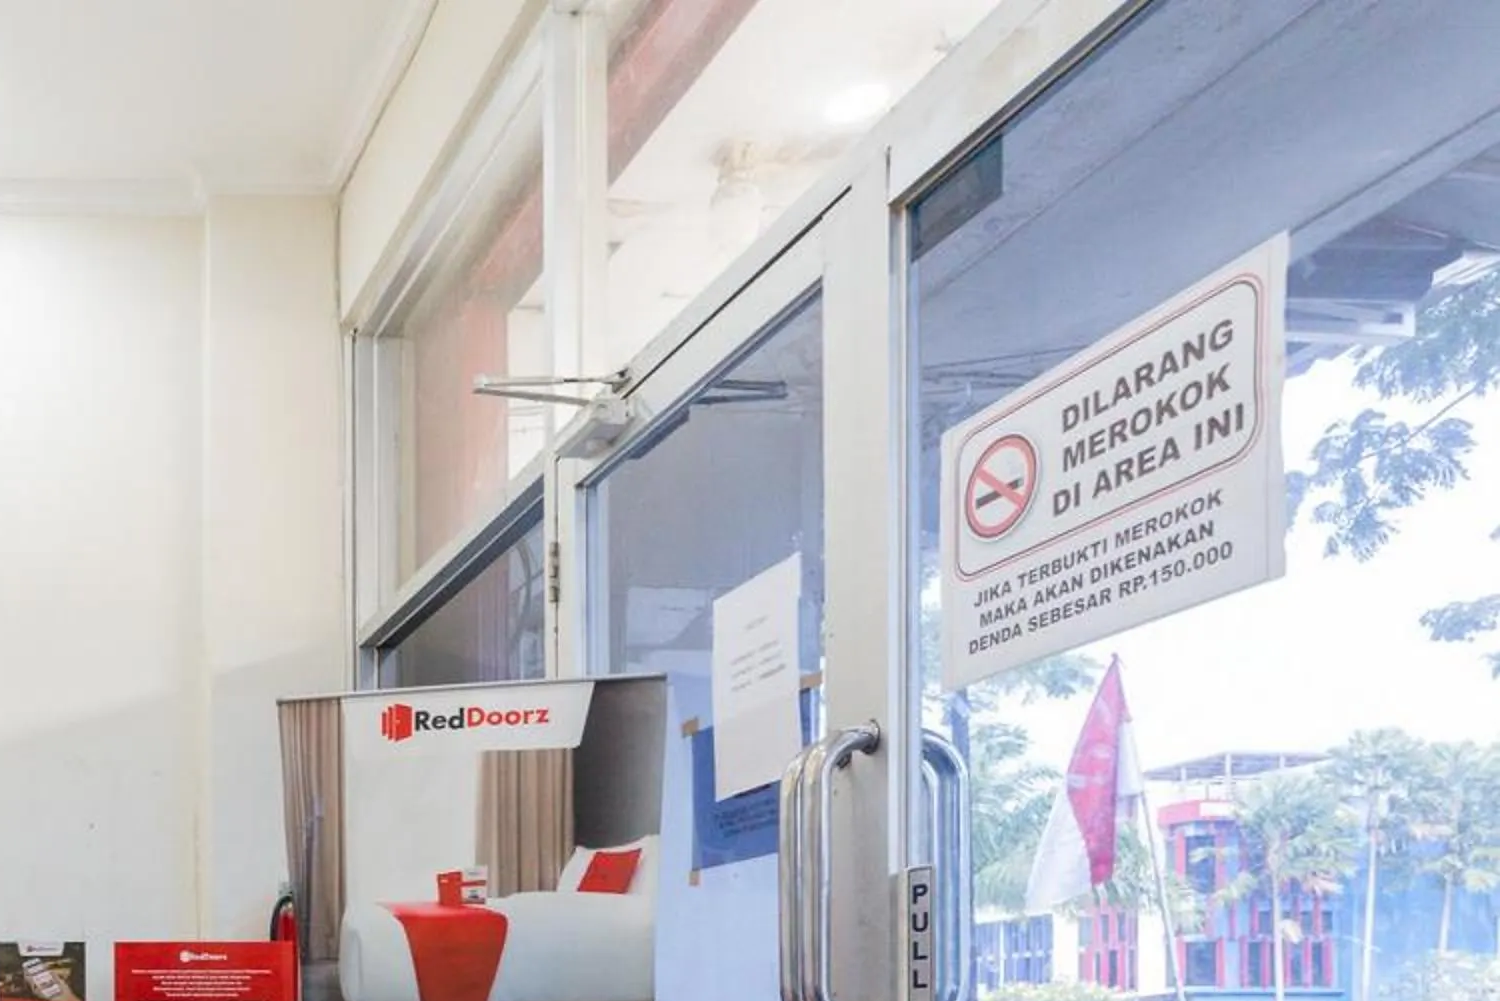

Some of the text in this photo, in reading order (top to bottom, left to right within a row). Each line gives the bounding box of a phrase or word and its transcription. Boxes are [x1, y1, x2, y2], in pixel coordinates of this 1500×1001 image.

[1060, 318, 1235, 433] DILARANG
[1061, 363, 1231, 472] MEROKOK
[1052, 403, 1245, 517] DI AREA INI
[968, 540, 1234, 656] DENDA SEBESAR RP.150.000
[974, 488, 1224, 609] JIKA TERBUKTI MEROKOK
[979, 520, 1215, 629] MAKA AKAN DIKENAKAN
[414, 707, 549, 732] RedDoorz
[912, 883, 929, 989] PULL
